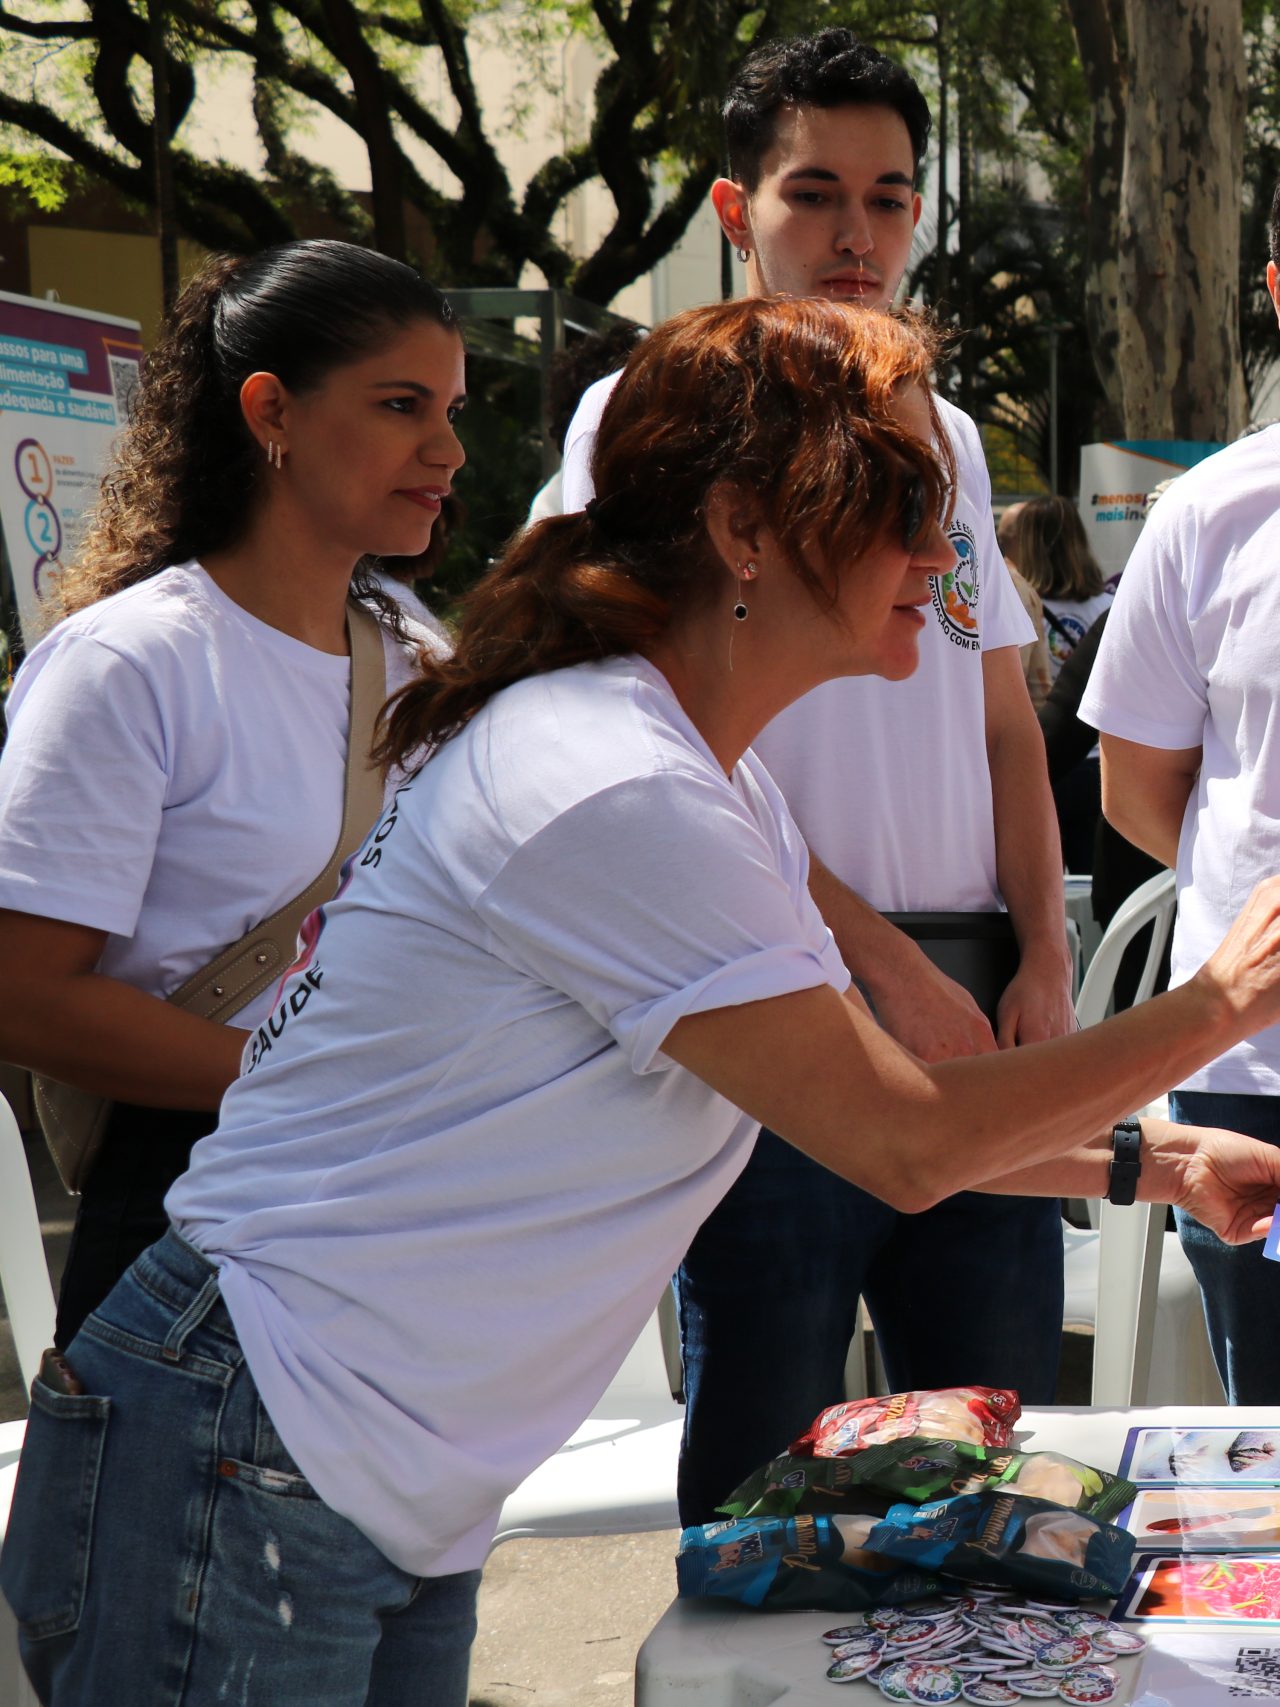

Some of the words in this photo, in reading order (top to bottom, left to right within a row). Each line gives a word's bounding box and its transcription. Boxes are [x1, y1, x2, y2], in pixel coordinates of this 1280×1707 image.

[31, 347, 58, 365] para
[59, 351, 84, 369] uma
[0, 363, 65, 390] limentação
[56, 401, 65, 414] e
[67, 401, 114, 421] saudável
[27, 452, 43, 484] 1
[36, 511, 52, 542] 2
[928, 575, 950, 635] RADUAÇÃO
[950, 632, 970, 650] COM
